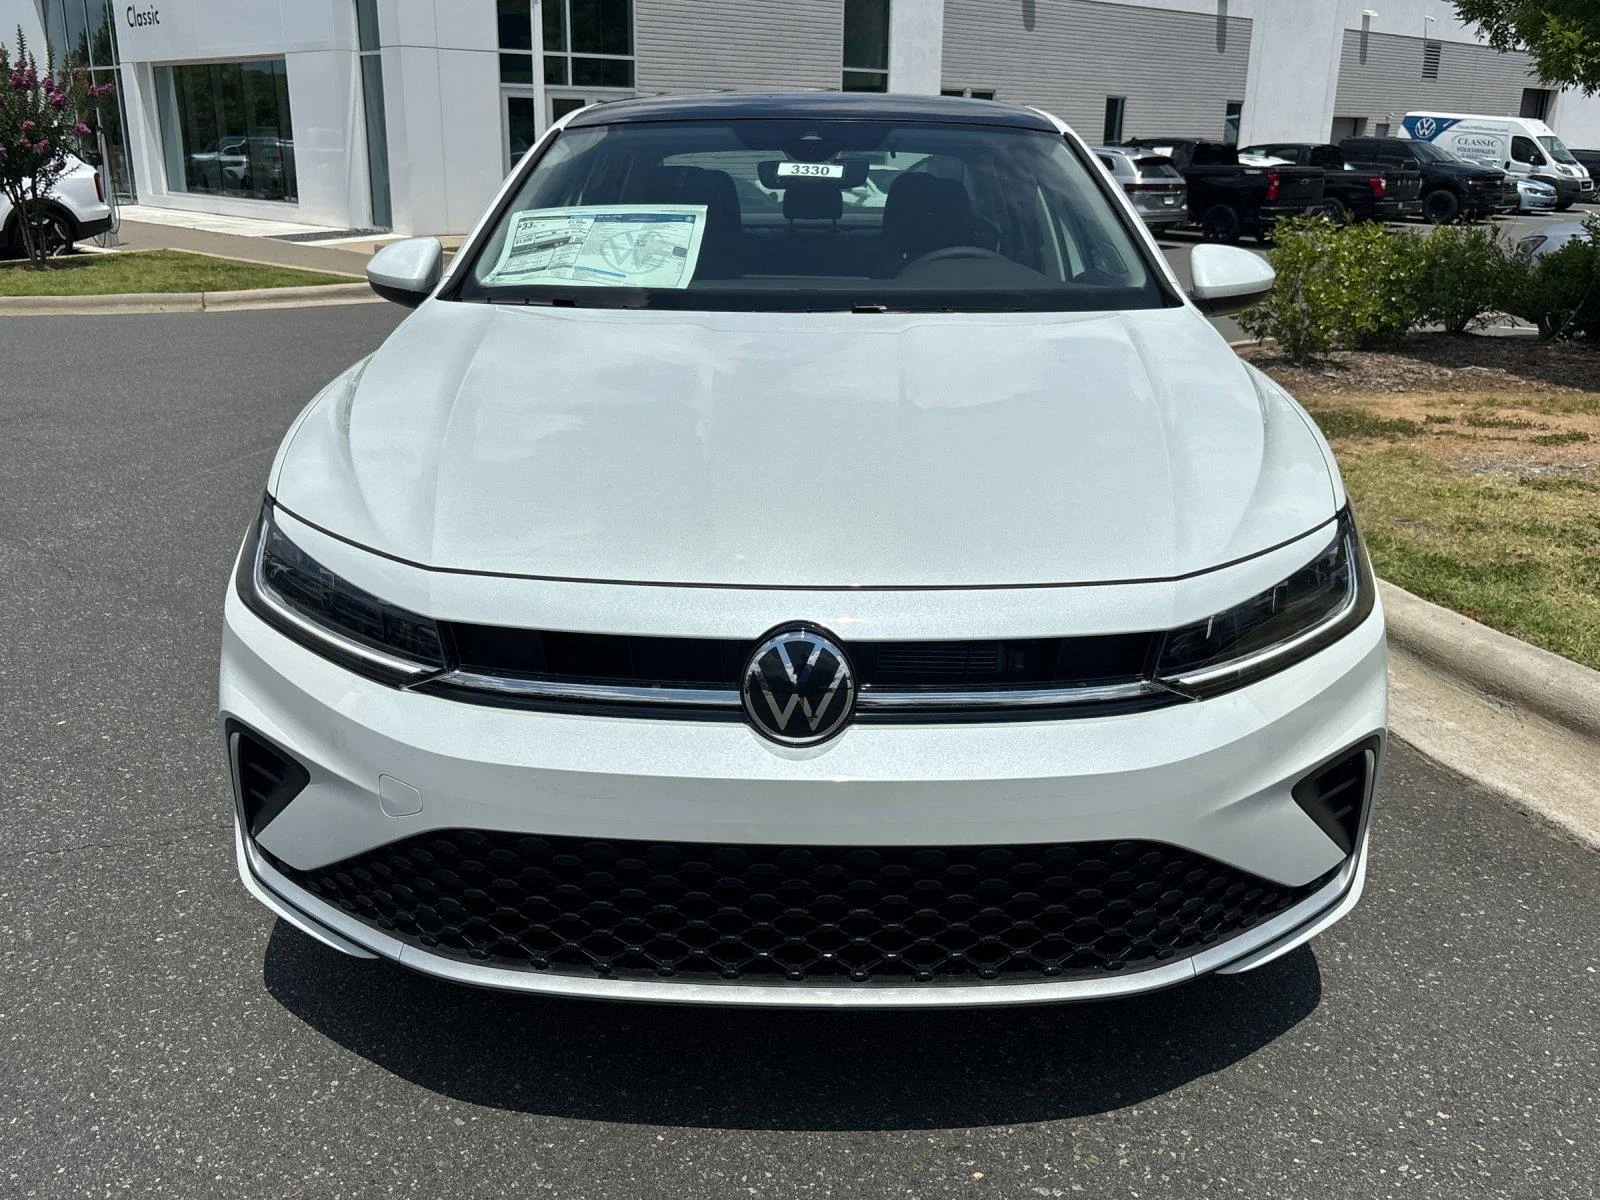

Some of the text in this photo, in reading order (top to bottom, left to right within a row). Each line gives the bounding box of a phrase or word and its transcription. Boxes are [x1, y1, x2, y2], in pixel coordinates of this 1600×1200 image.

[127, 5, 160, 28] Classic
[1457, 138, 1498, 147] CLASSIC
[1456, 146, 1496, 155] VOLKSWAGEN
[790, 164, 830, 176] 3330
[745, 631, 852, 737] VW
